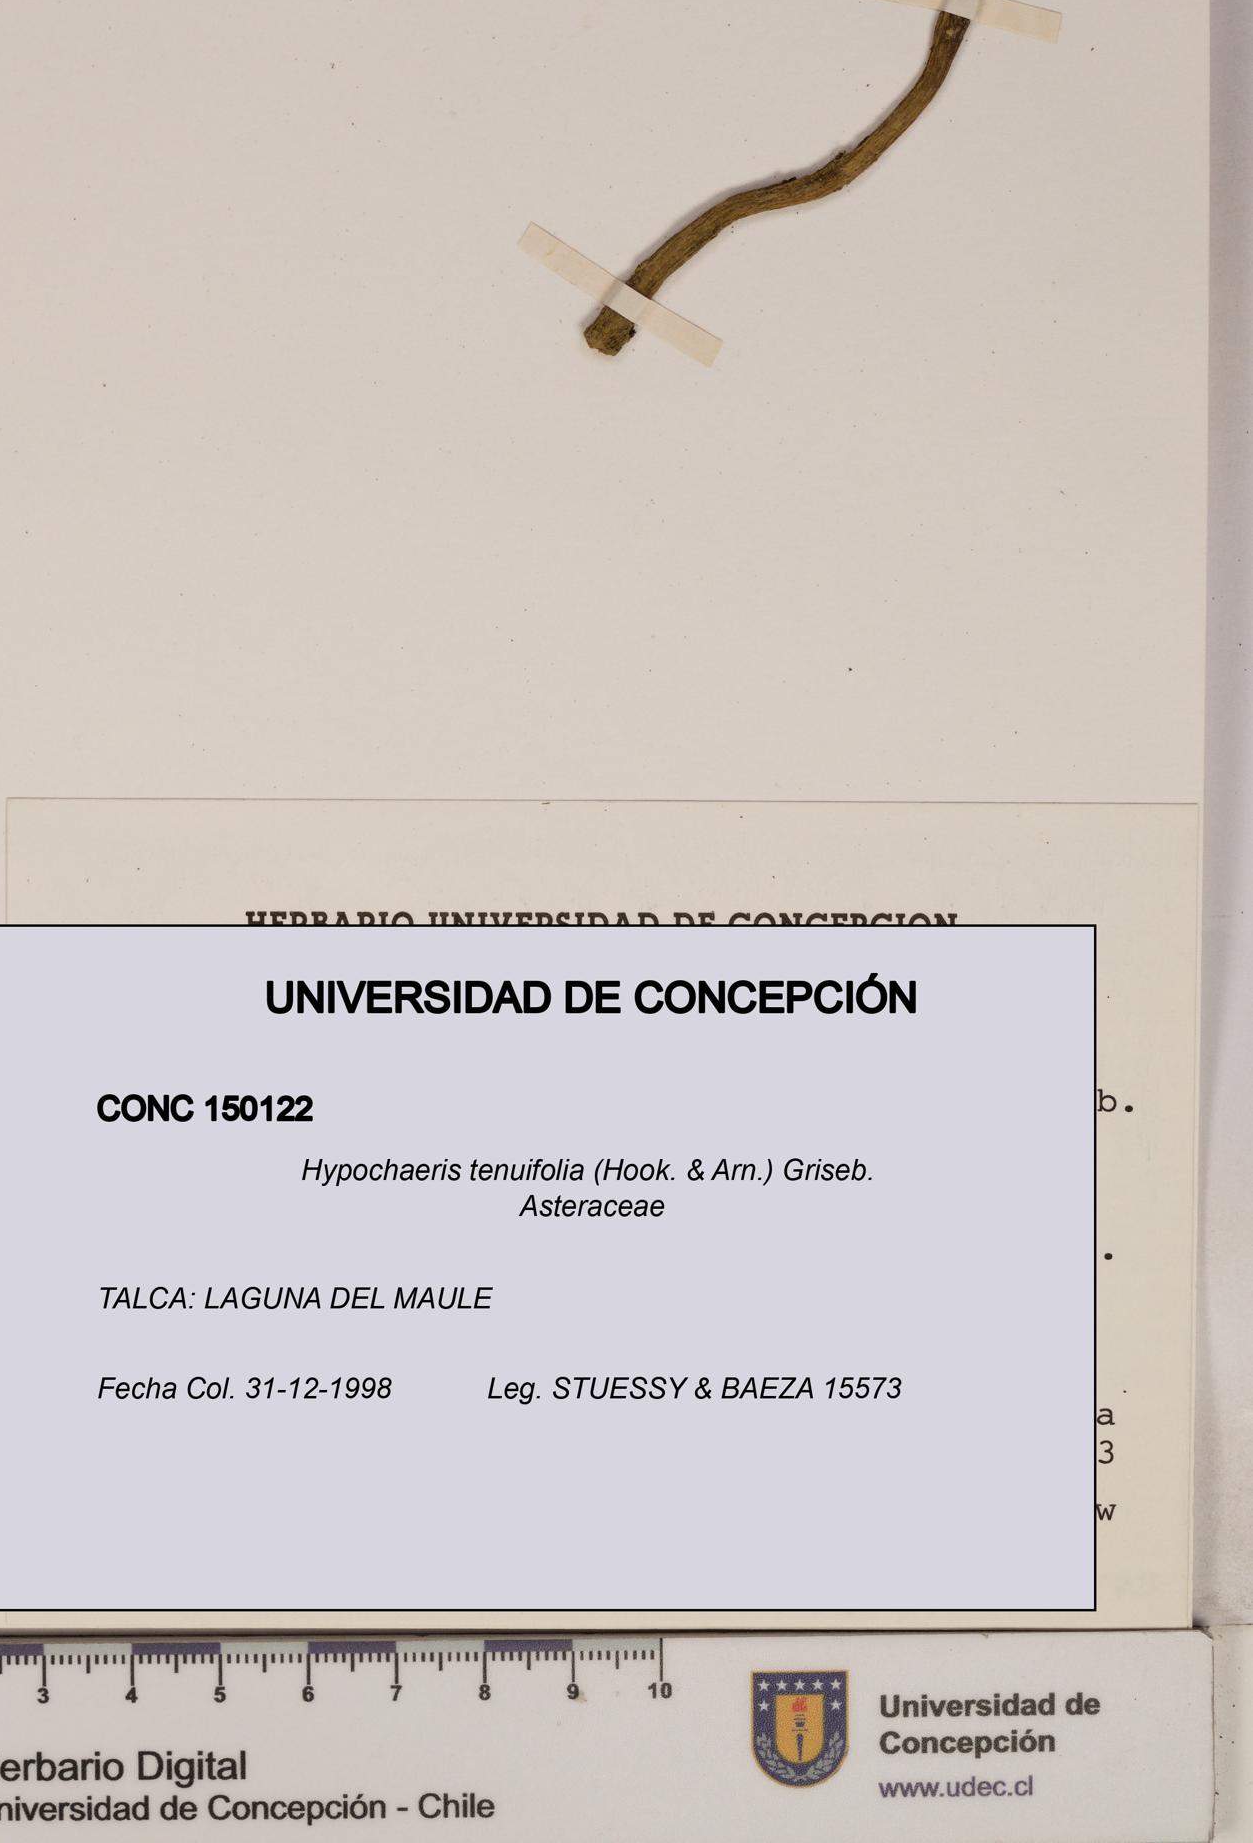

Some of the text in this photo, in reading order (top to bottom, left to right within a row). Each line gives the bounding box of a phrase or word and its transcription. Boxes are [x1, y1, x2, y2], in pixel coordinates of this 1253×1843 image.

[37, 1687, 50, 1705] 3
[125, 1686, 139, 1704] 4
[214, 1686, 227, 1704] 5
[302, 1686, 315, 1703] 6
[390, 1685, 403, 1702] 7
[478, 1684, 492, 1702] 8
[567, 1684, 580, 1701] 9
[648, 1683, 673, 1700] 10
[879, 1691, 1101, 1719] Universidad de
[878, 1728, 1056, 1759] Concepción
[137, 1749, 247, 1789] Digital
[878, 1774, 1034, 1799] www.udec.cl
[159, 1794, 199, 1822] de
[207, 1793, 387, 1827] Concepción
[418, 1792, 496, 1820] Chile
